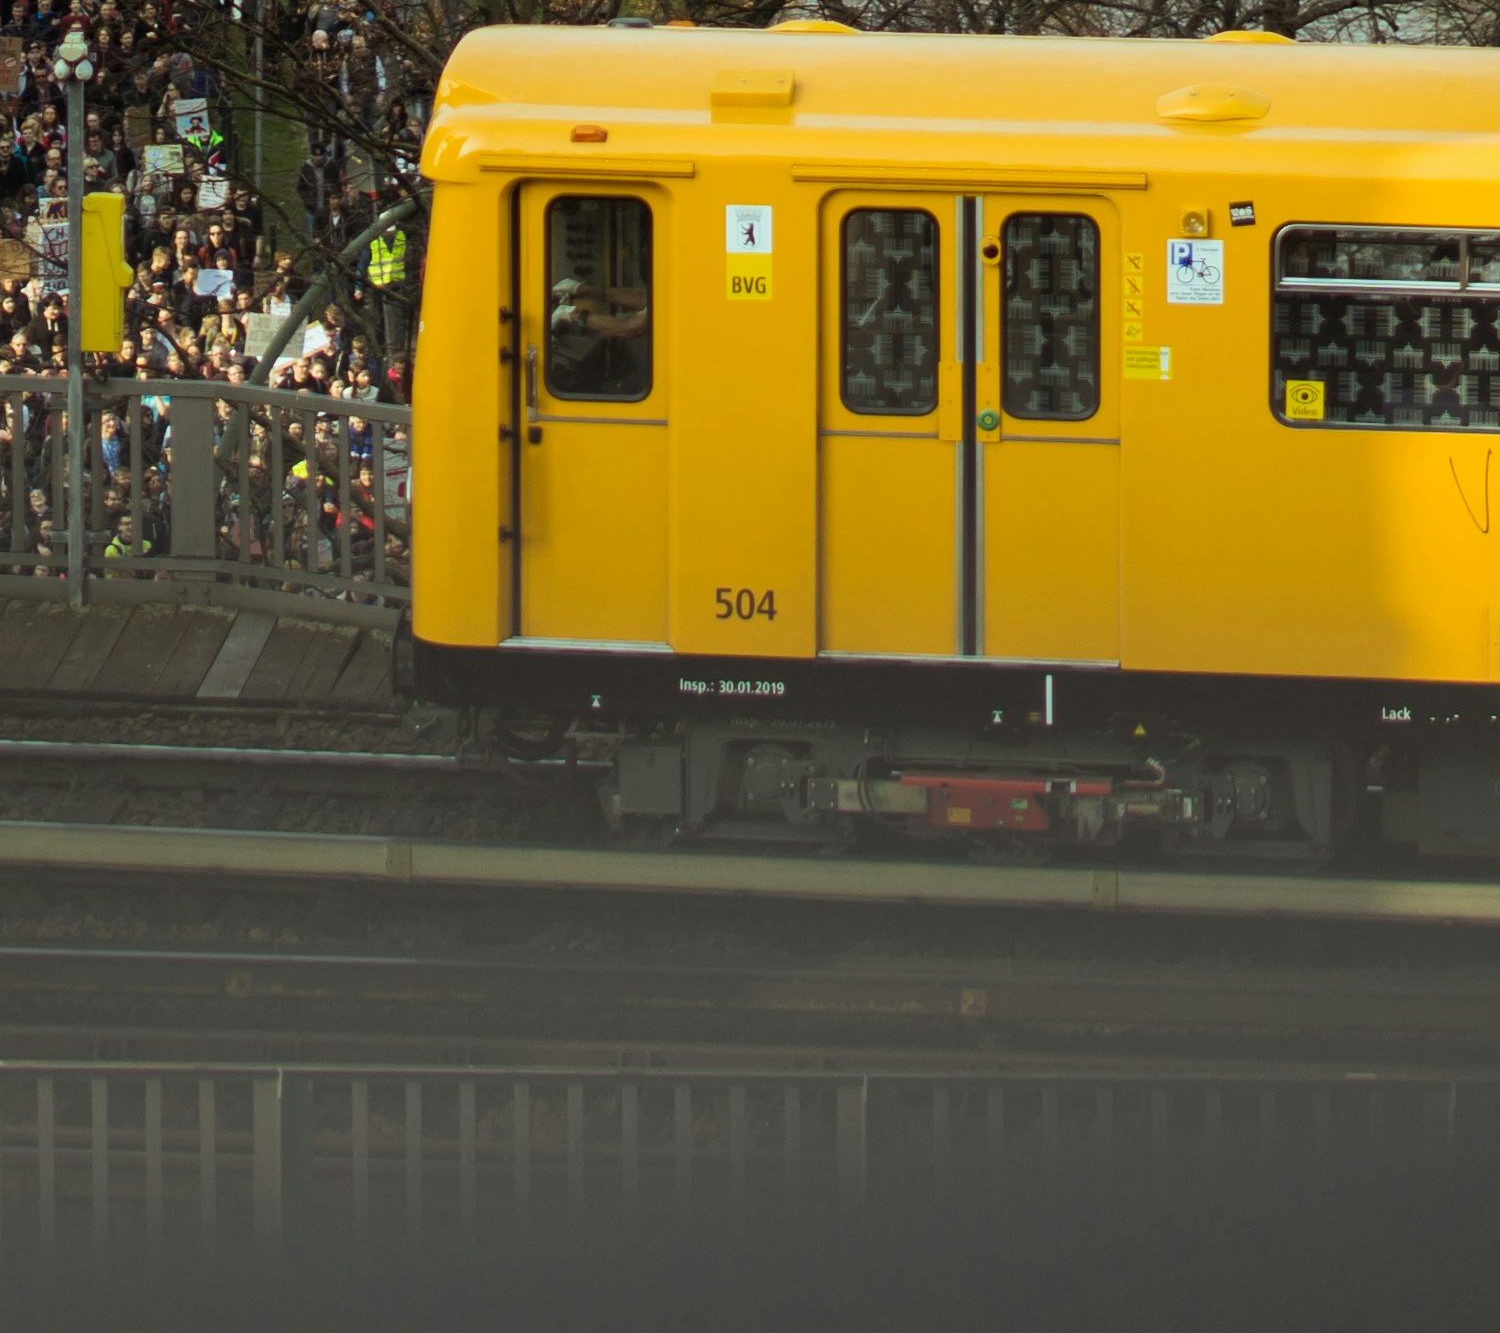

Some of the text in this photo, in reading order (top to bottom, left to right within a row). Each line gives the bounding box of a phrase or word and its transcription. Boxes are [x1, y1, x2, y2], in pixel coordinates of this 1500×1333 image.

[732, 276, 767, 294] BVG
[1292, 406, 1319, 416] Video
[715, 587, 777, 621] 504
[679, 678, 785, 695] Insp.: 30.01.2019
[1382, 707, 1411, 721] Lack
